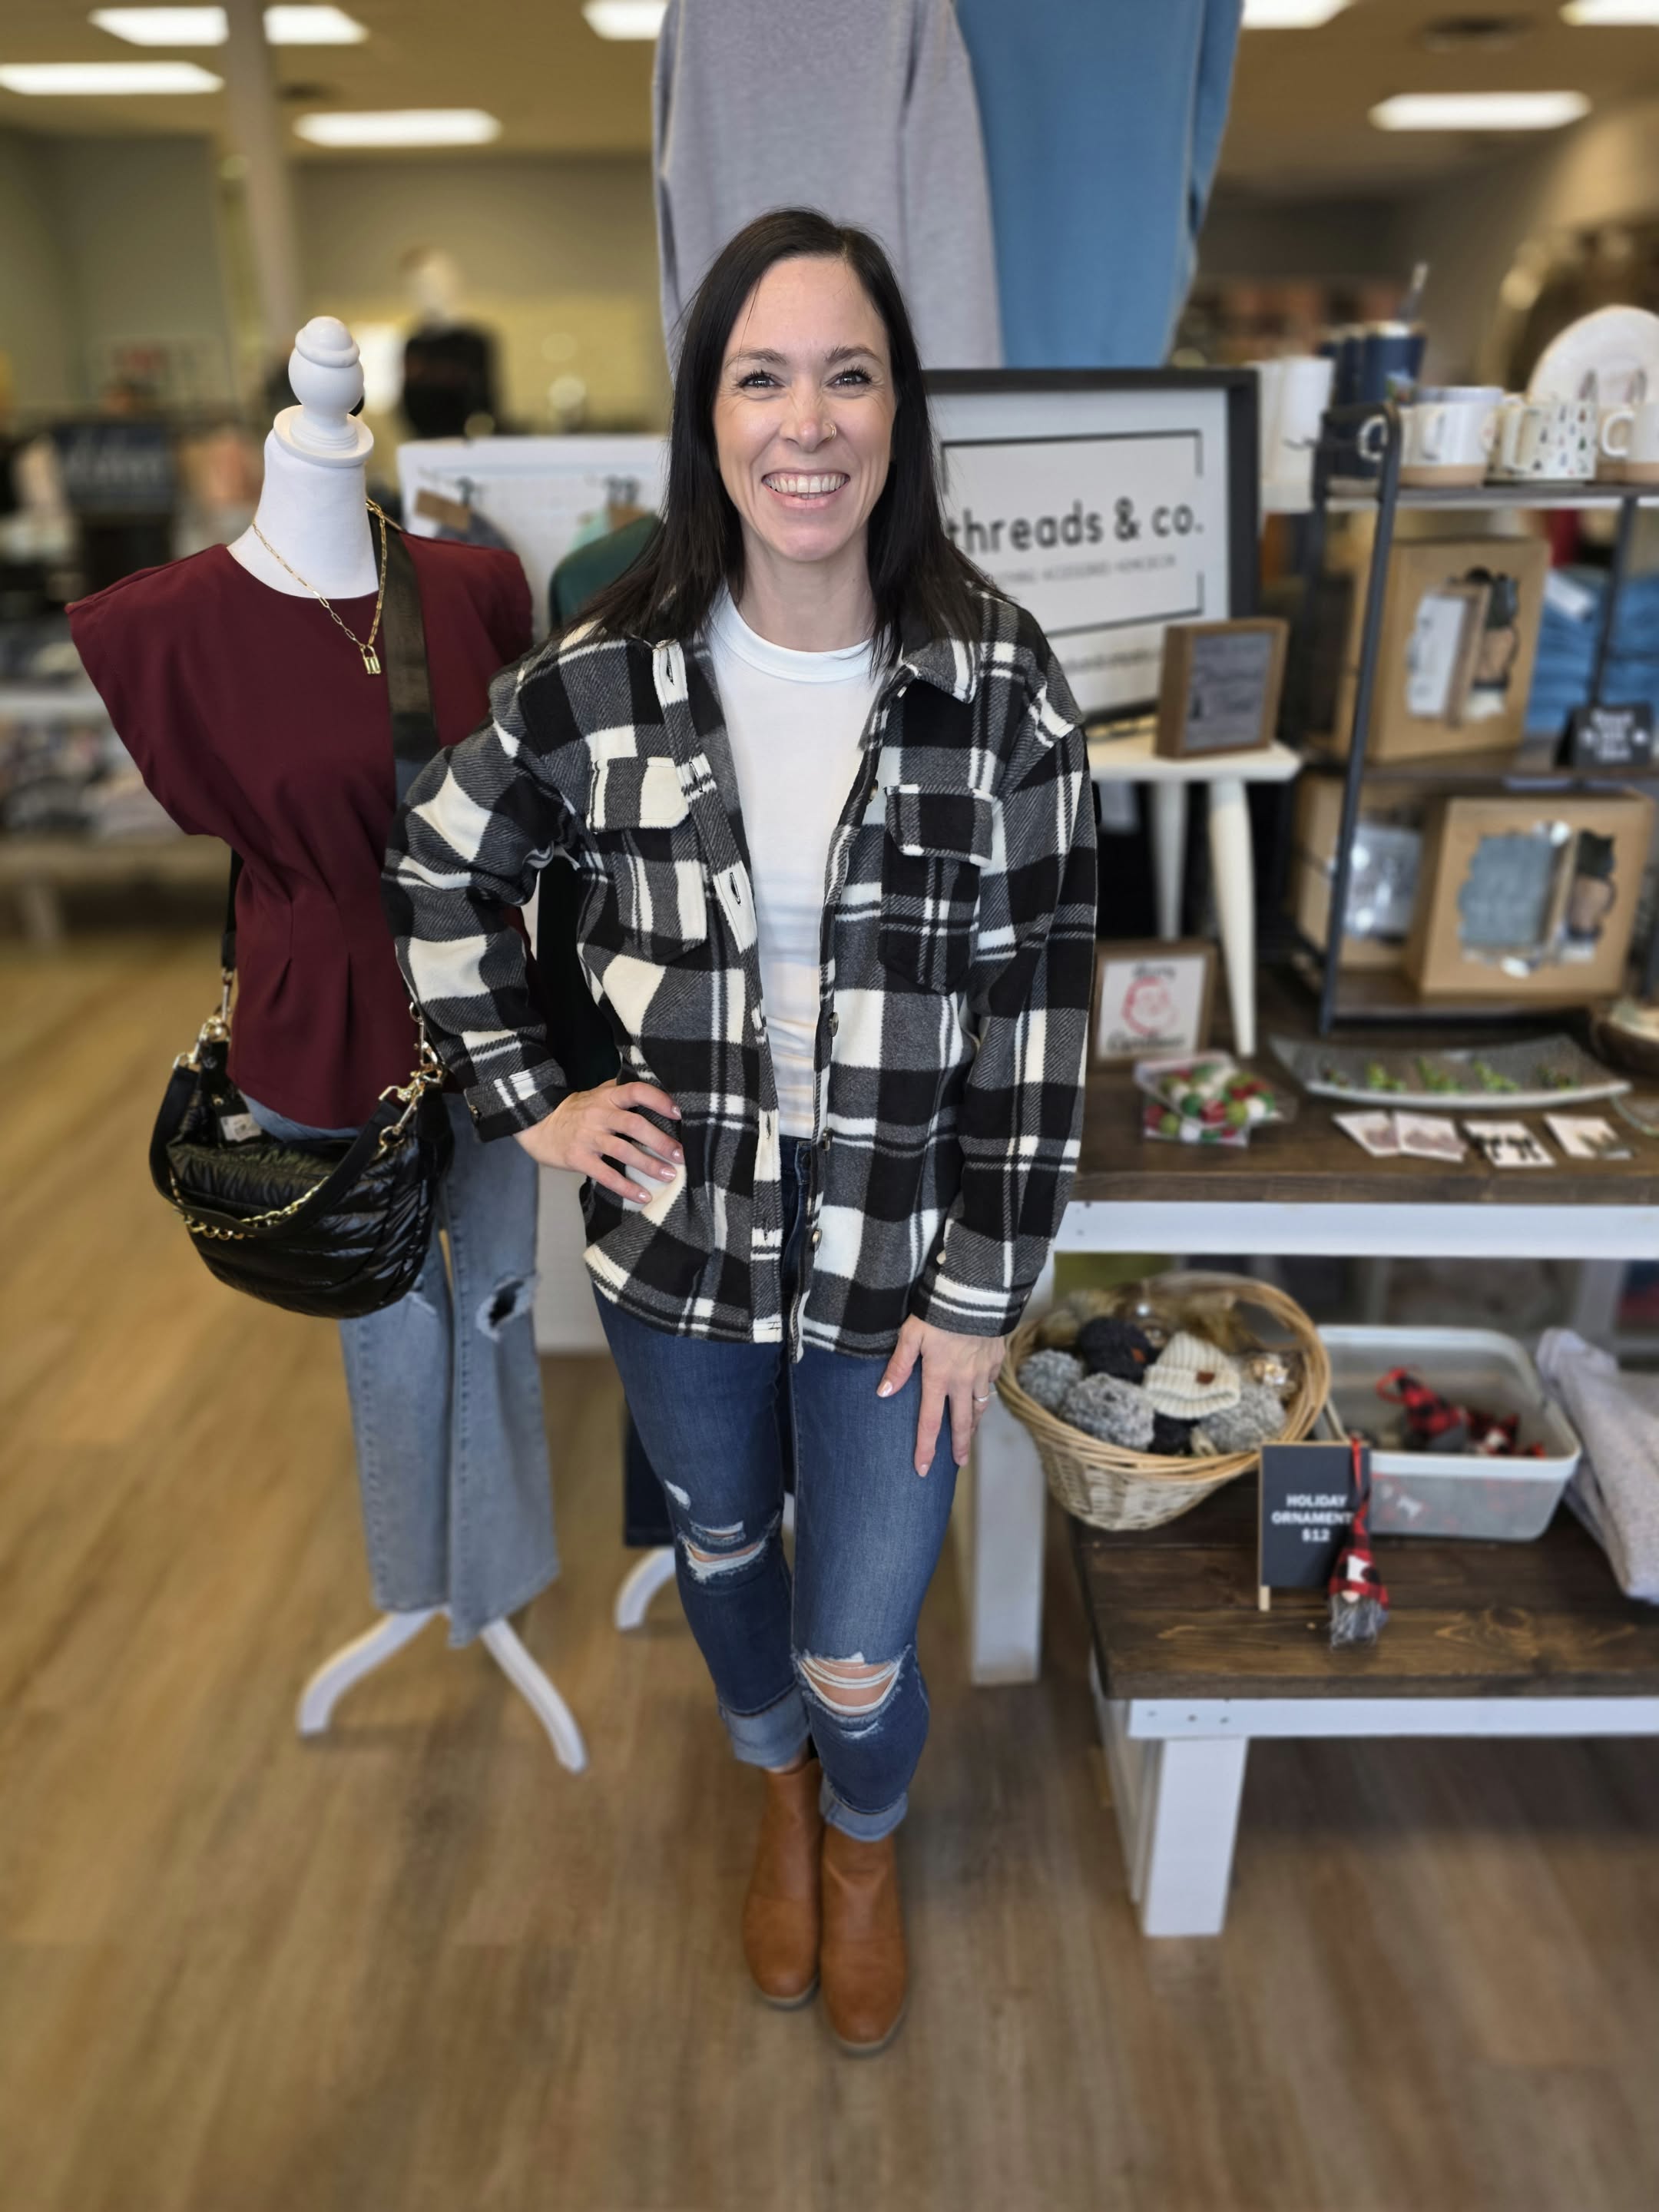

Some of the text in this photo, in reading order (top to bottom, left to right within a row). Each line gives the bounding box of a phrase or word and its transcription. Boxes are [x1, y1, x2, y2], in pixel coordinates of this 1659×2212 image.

[945, 496, 1204, 555] threads & co.
[1286, 1493, 1348, 1508] HOLIDAY
[1271, 1511, 1354, 1525] ORNAMENT
[1302, 1528, 1330, 1543] $12
